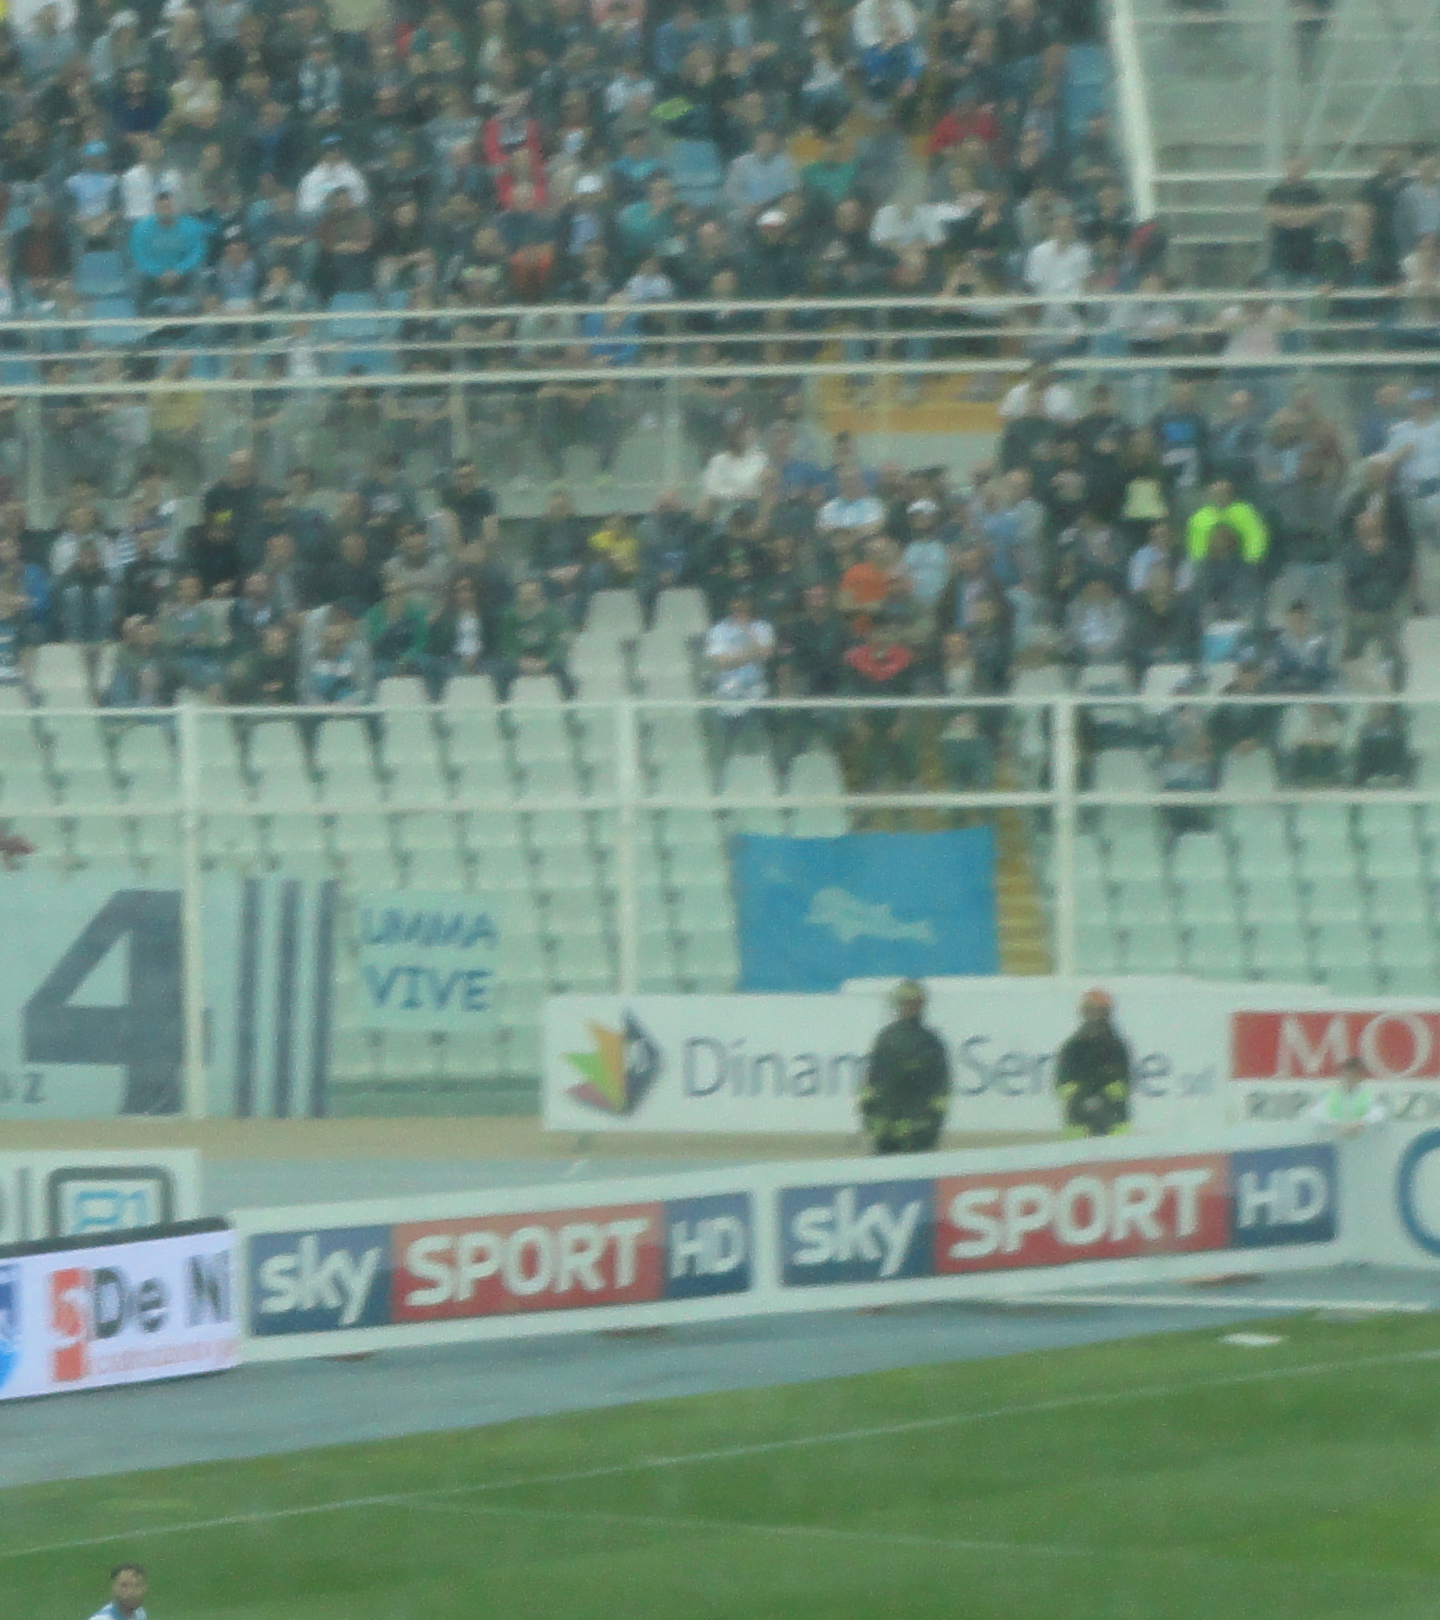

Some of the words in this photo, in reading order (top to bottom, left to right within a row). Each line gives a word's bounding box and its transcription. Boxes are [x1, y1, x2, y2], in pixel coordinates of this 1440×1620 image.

[24, 889, 213, 1114] 4
[363, 963, 493, 1012] VIVE
[258, 1236, 382, 1326] sky
[404, 1217, 651, 1308] SPORT
[670, 1216, 745, 1279] HD
[792, 1190, 922, 1277] sky
[948, 1168, 1215, 1260] SPORT
[1236, 1165, 1328, 1229] HD
[93, 1266, 168, 1339] De
